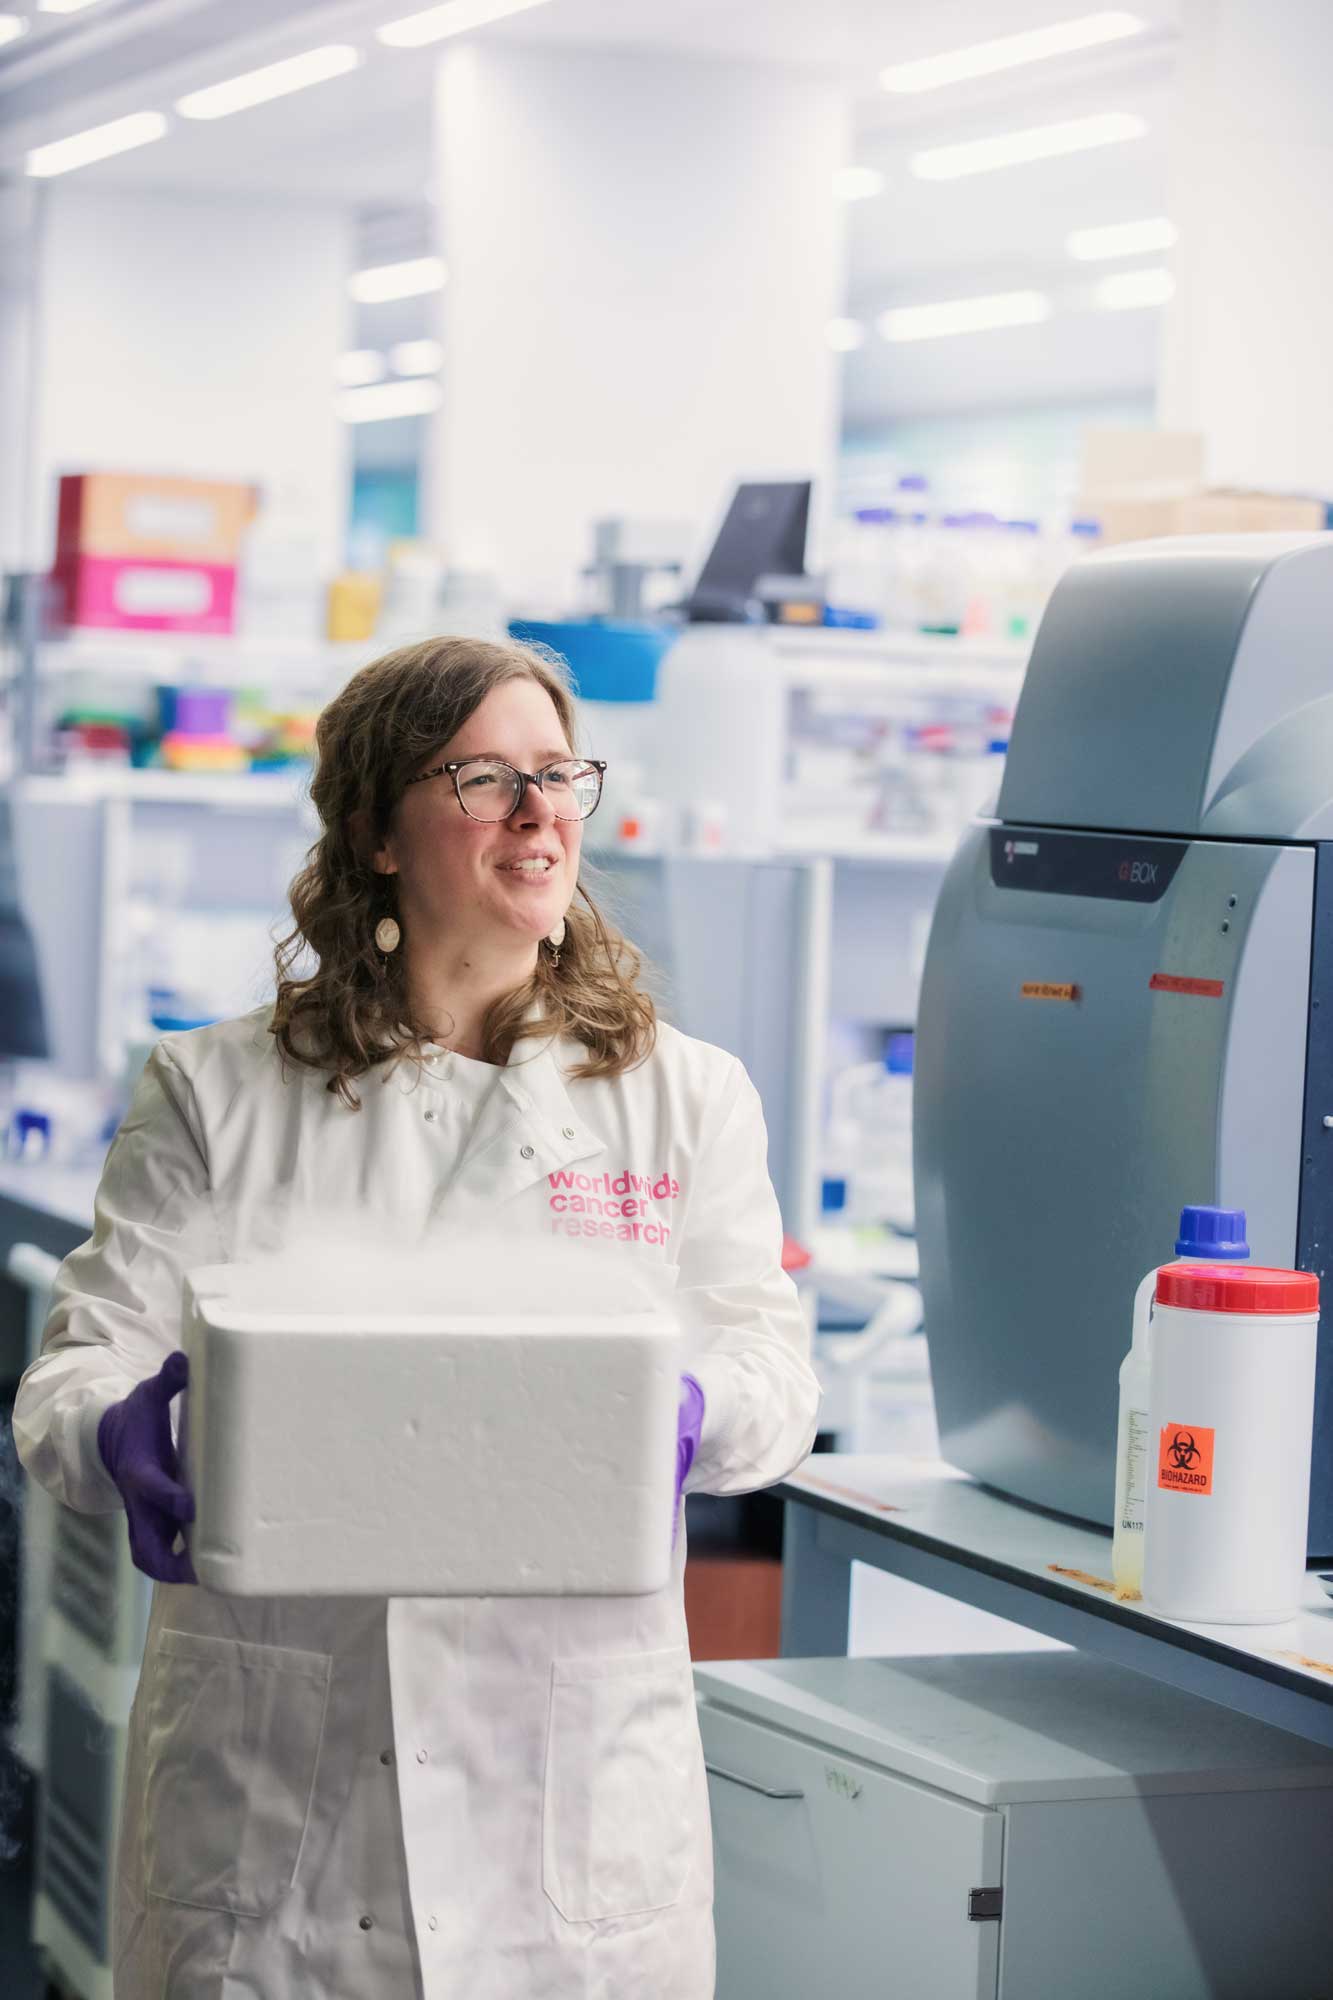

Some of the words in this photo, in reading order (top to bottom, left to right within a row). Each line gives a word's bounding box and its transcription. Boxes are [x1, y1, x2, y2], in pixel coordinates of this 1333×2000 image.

[549, 1193, 649, 1218] cancer
[551, 1217, 671, 1246] research
[1161, 1468, 1207, 1487] BIOHAZARD
